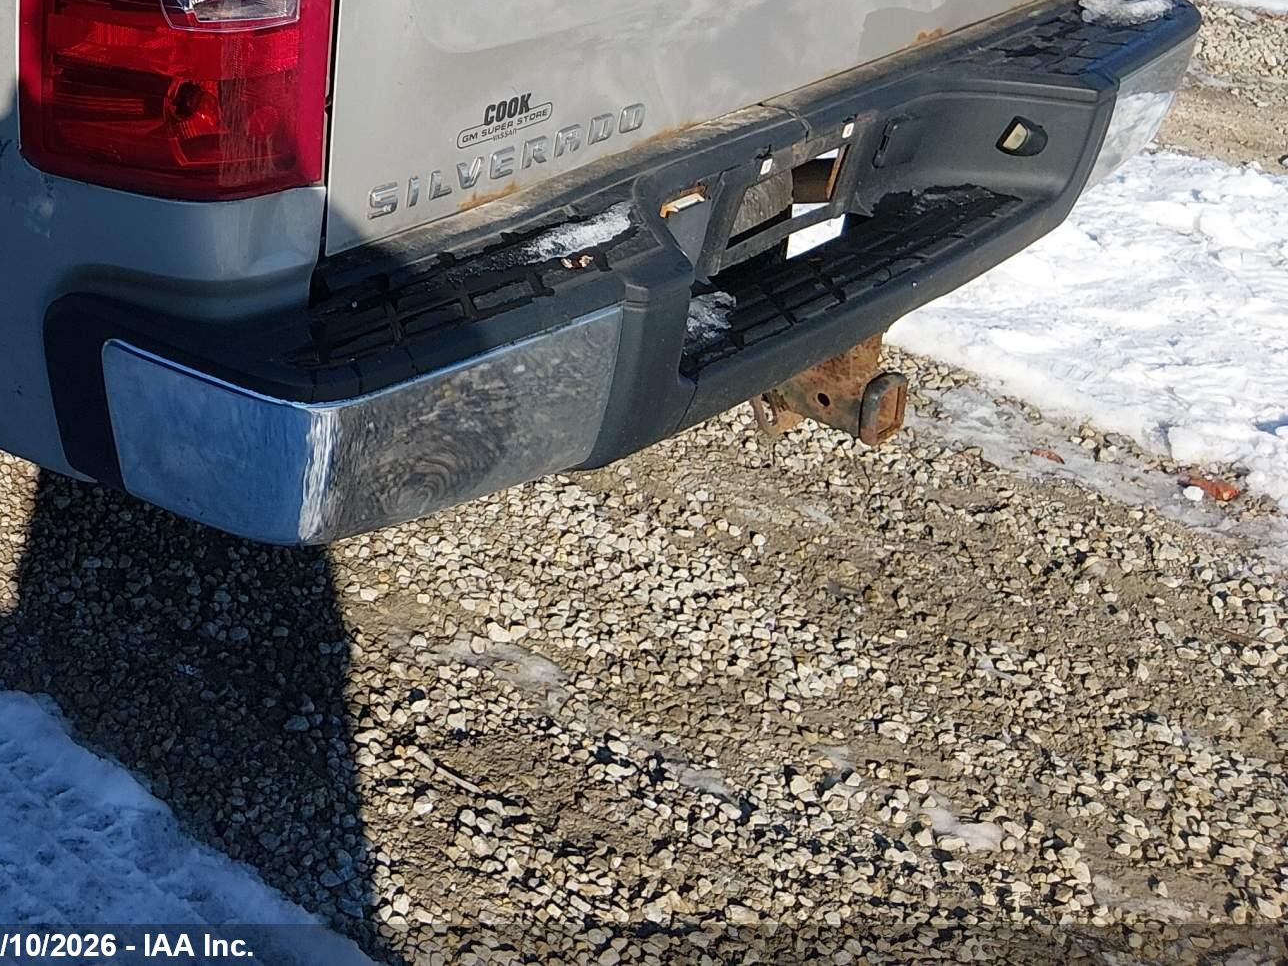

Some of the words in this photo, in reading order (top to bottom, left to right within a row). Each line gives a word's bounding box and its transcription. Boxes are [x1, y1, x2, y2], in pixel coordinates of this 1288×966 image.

[462, 132, 478, 143] GM
[481, 120, 514, 137] SUPER
[516, 108, 549, 126] STORE
[484, 93, 532, 126] COOK
[368, 102, 646, 220] SILVERADO
